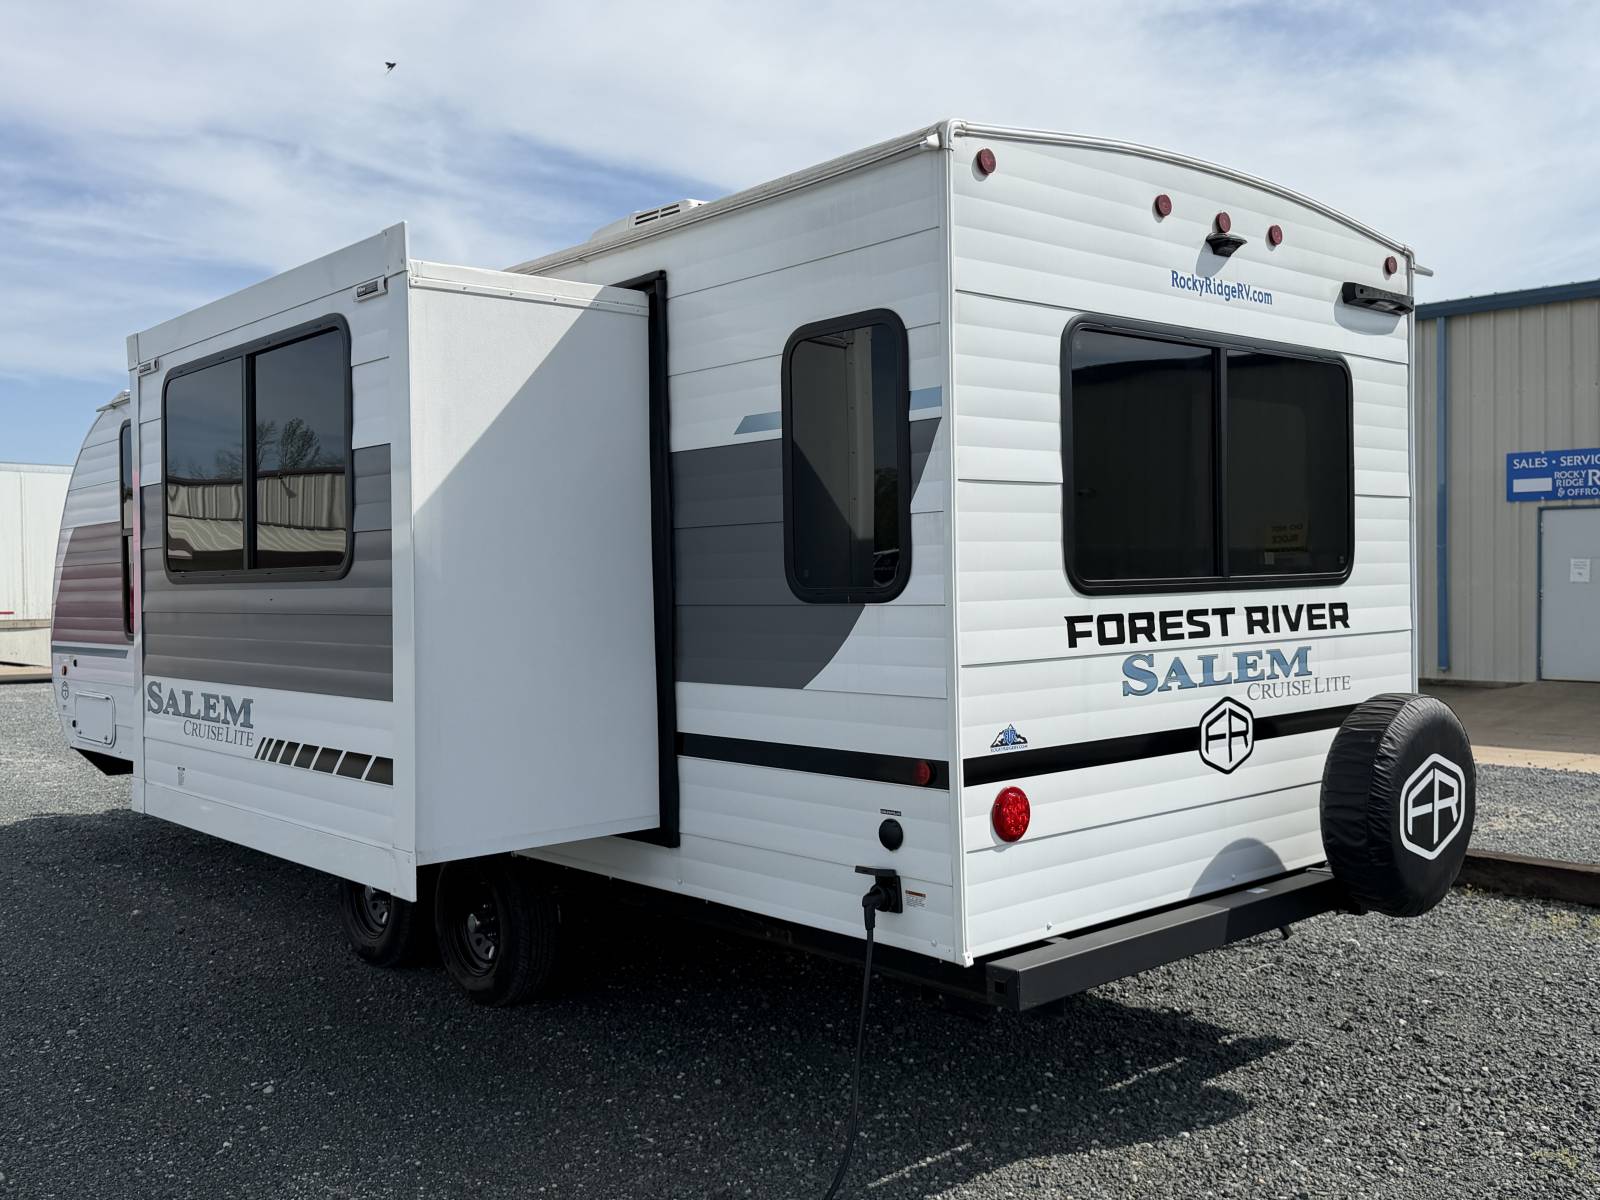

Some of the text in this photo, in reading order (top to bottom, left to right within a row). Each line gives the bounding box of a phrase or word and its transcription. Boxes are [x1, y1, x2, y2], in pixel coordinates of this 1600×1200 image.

[1171, 270, 1273, 305] RockyRidgeRV.com
[1513, 457, 1548, 469] SALES
[1554, 470, 1586, 479] ROCKY
[1556, 478, 1584, 487] RIDGE
[1557, 487, 1600, 497] & OFFRO
[1064, 602, 1350, 648] FOREST RIVER
[1122, 645, 1313, 697] SALEM
[147, 681, 254, 729] SALEM
